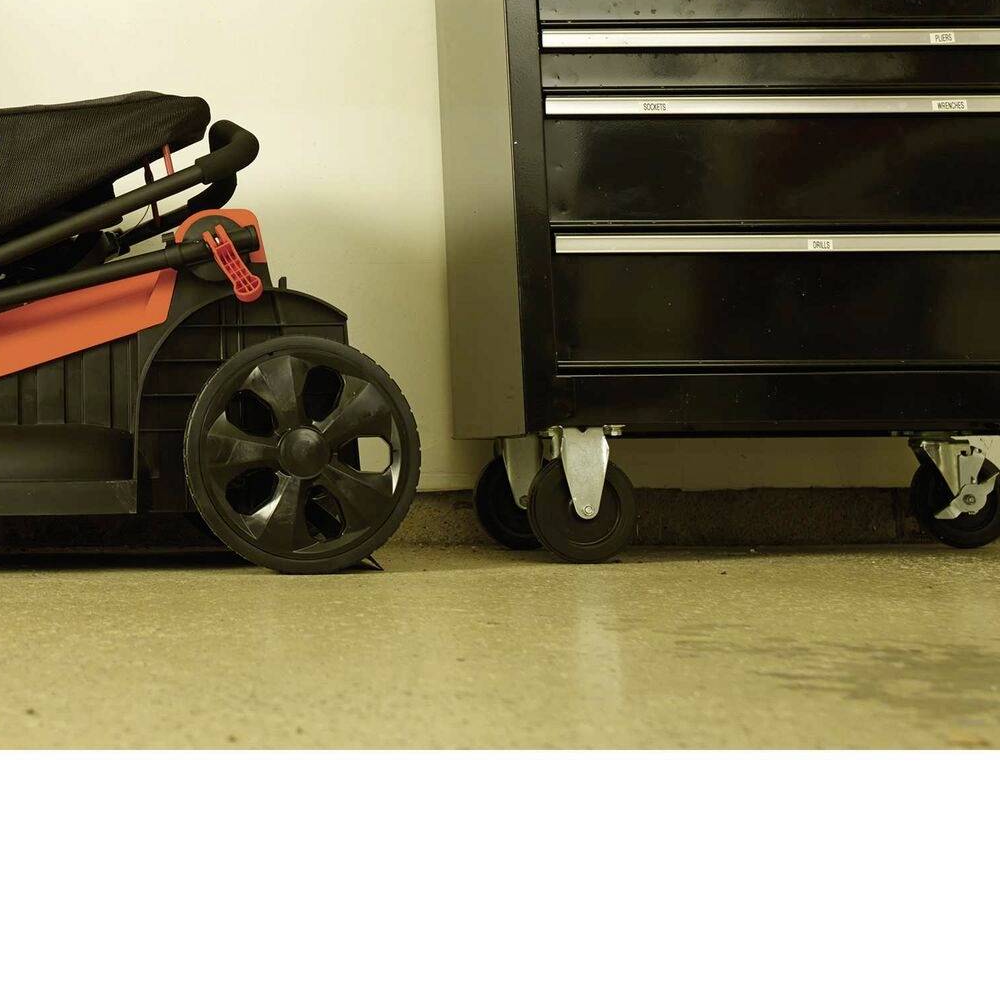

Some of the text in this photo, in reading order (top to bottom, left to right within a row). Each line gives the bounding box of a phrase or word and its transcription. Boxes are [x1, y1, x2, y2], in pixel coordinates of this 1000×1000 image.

[934, 33, 953, 43] PLIERS
[642, 102, 667, 111] SOCKETS
[937, 101, 965, 110] WRENCHES
[812, 240, 831, 250] DRILLS
